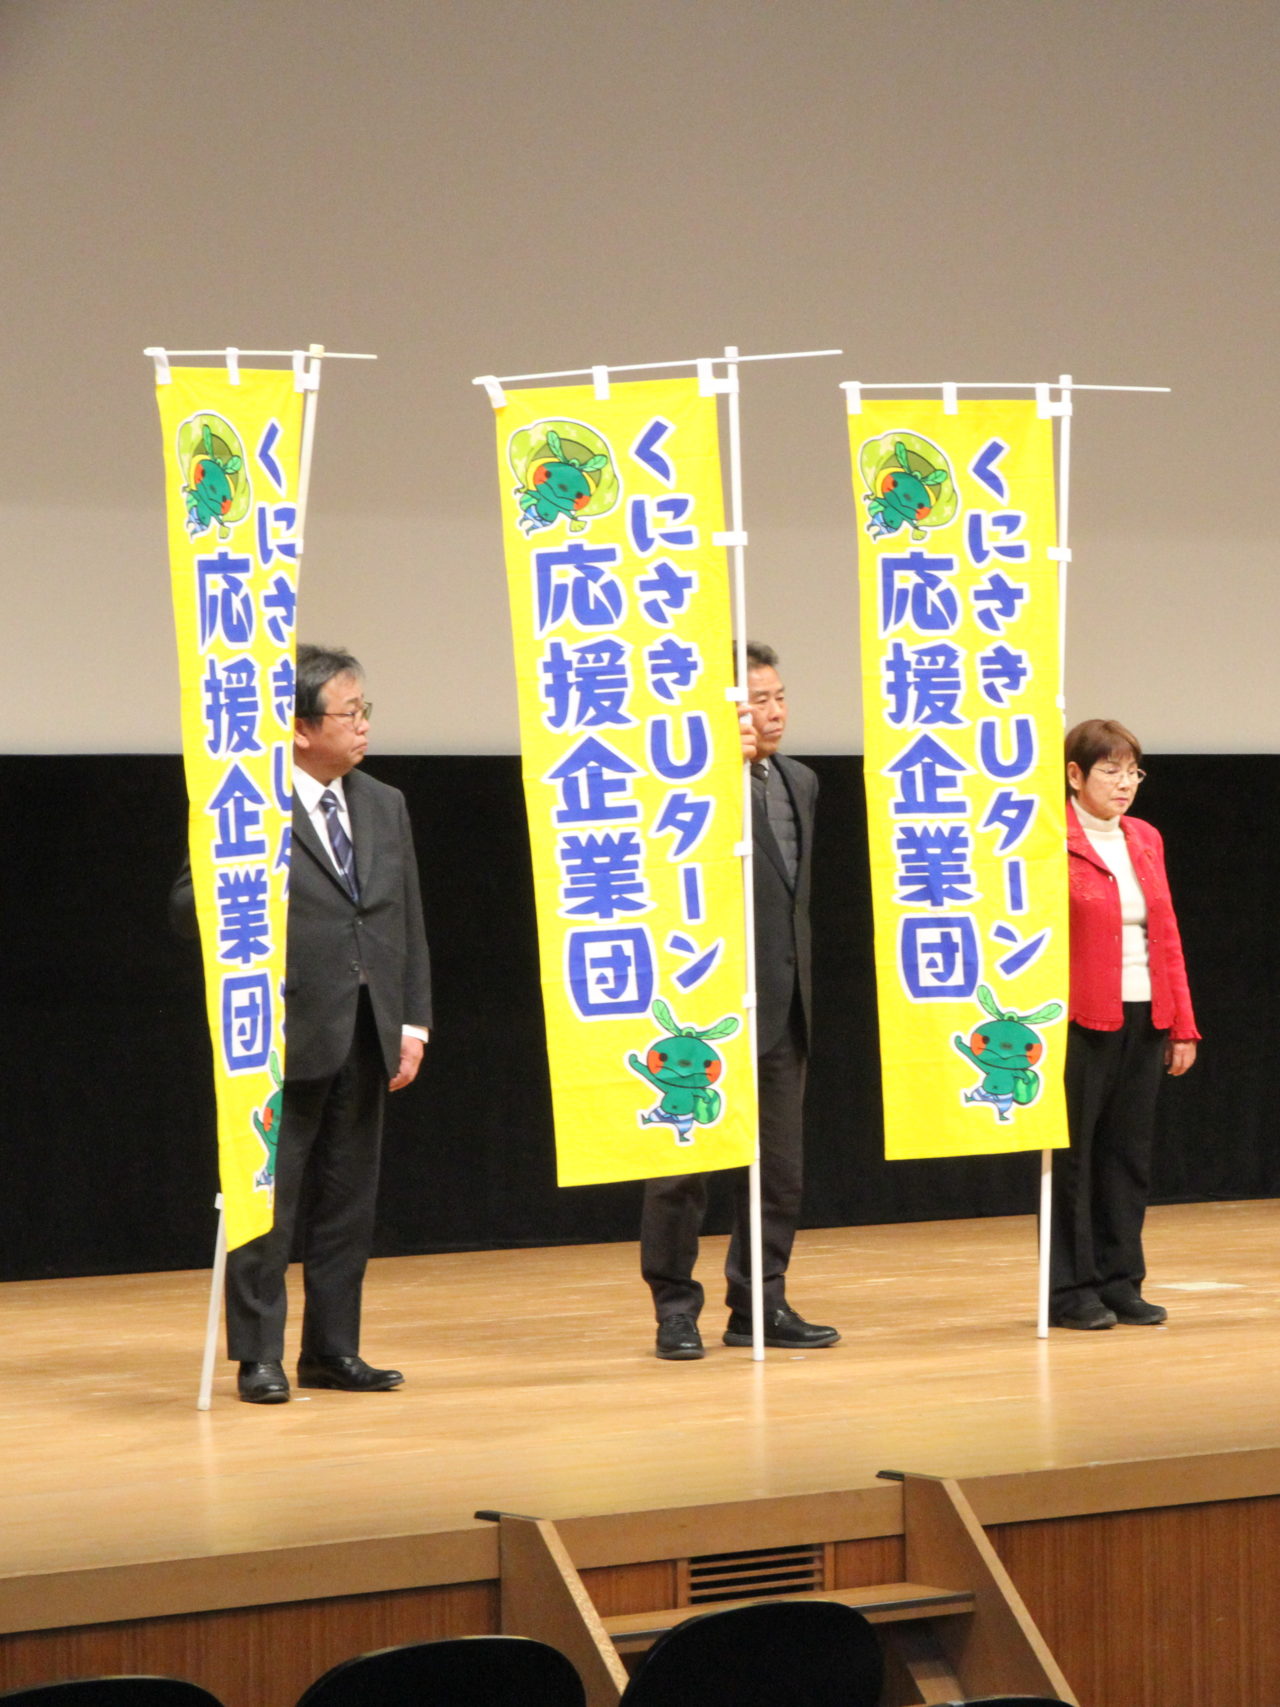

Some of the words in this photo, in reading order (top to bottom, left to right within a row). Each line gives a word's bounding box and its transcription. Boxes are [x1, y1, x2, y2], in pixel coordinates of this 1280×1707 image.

[198, 551, 271, 1071] 応援企業団
[535, 543, 655, 1017] 応援企業団
[631, 421, 719, 988] くにさきUターン
[882, 551, 979, 998] 応援企業団
[969, 442, 1045, 975] くにさきUターン
